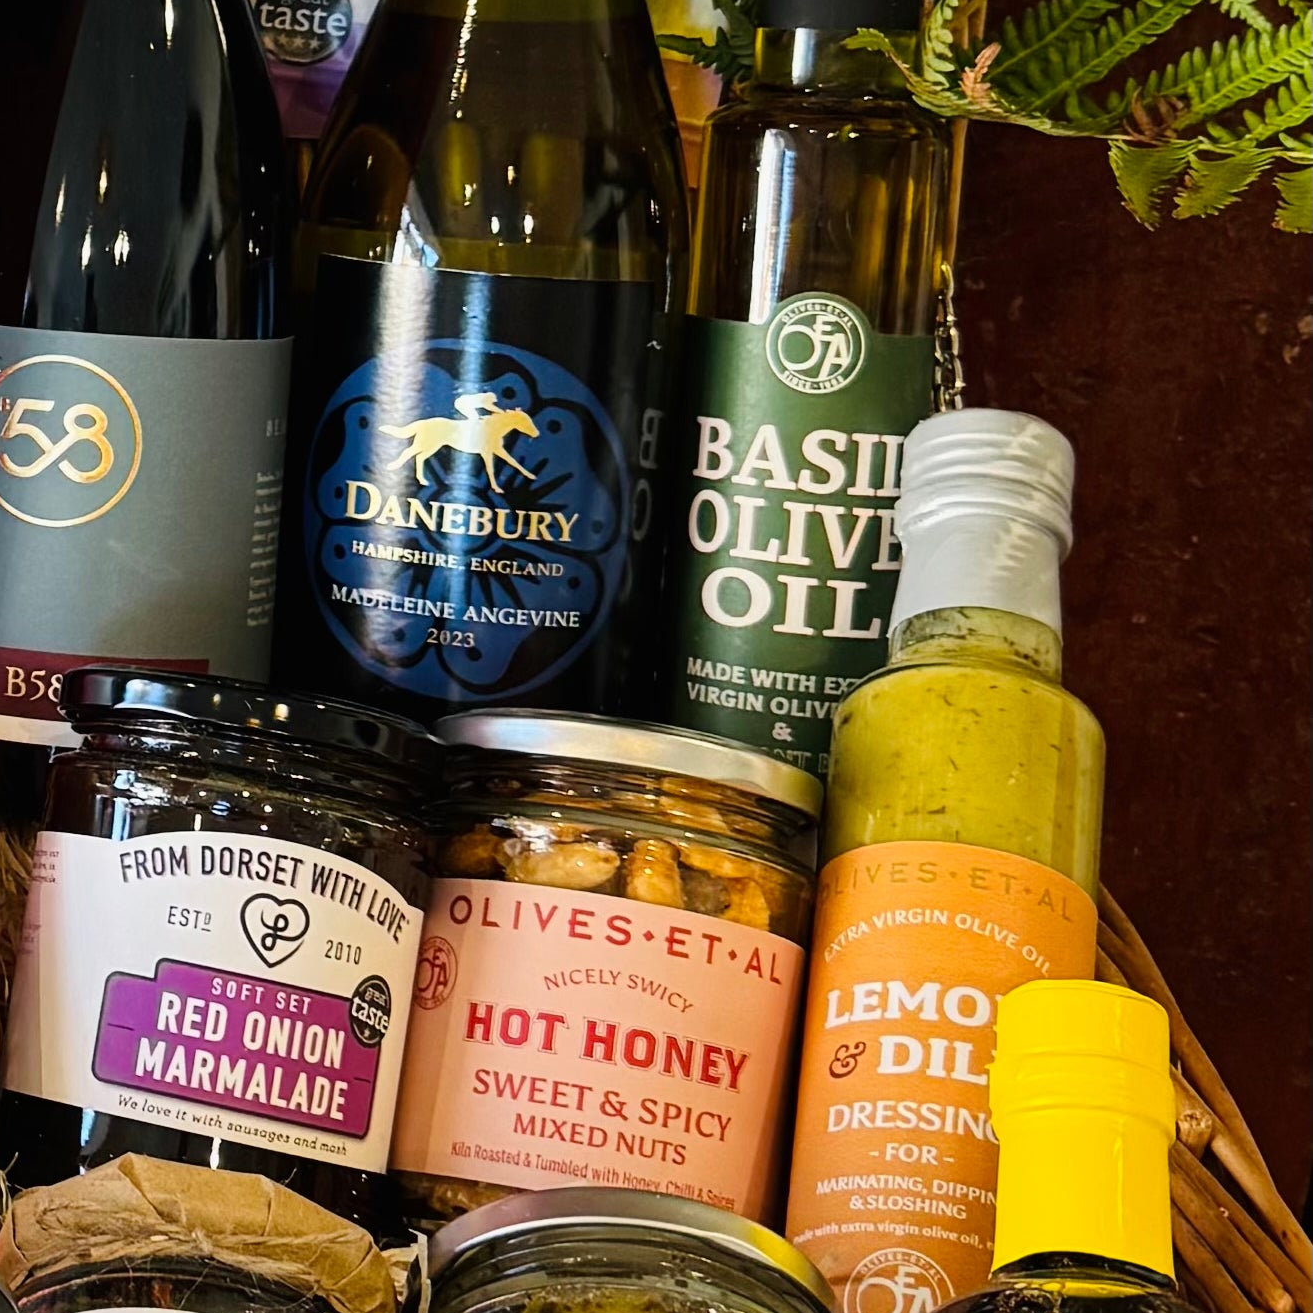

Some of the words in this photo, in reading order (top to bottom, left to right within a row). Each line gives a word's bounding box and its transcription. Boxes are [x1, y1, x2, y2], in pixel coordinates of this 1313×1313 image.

[259, 0, 348, 38] taste
[345, 480, 580, 543] DANEBURY
[470, 558, 564, 577] ENGLAND
[331, 583, 456, 620] MADELEINE
[462, 606, 581, 628] ANGEVINE
[701, 568, 882, 641] OIL
[426, 627, 475, 648] 2023
[686, 656, 746, 684] MADE
[751, 667, 816, 694] WITH
[686, 682, 764, 713] VIRGIN
[120, 846, 190, 883] FROM
[201, 846, 304, 889] DORSET
[311, 862, 365, 910] WITH
[824, 919, 869, 964] EXTRA
[872, 907, 948, 931] VIRGIN
[954, 912, 1018, 948] OLIVE
[1021, 943, 1051, 977] OIL
[212, 977, 264, 1005] SOFT
[276, 989, 311, 1015] SET
[544, 968, 622, 991] NICELY
[627, 974, 694, 1015] SWICY
[157, 991, 228, 1042] RED
[243, 1010, 344, 1070] ONION
[464, 1002, 569, 1054] HOT
[581, 1016, 750, 1094] HONEY
[135, 1037, 349, 1122] MARMALADE
[473, 1068, 592, 1113] SWEET
[599, 1090, 629, 1121] &
[638, 1098, 731, 1143] SPICY
[514, 1113, 608, 1148] MIXED
[617, 1129, 686, 1166] NUTS
